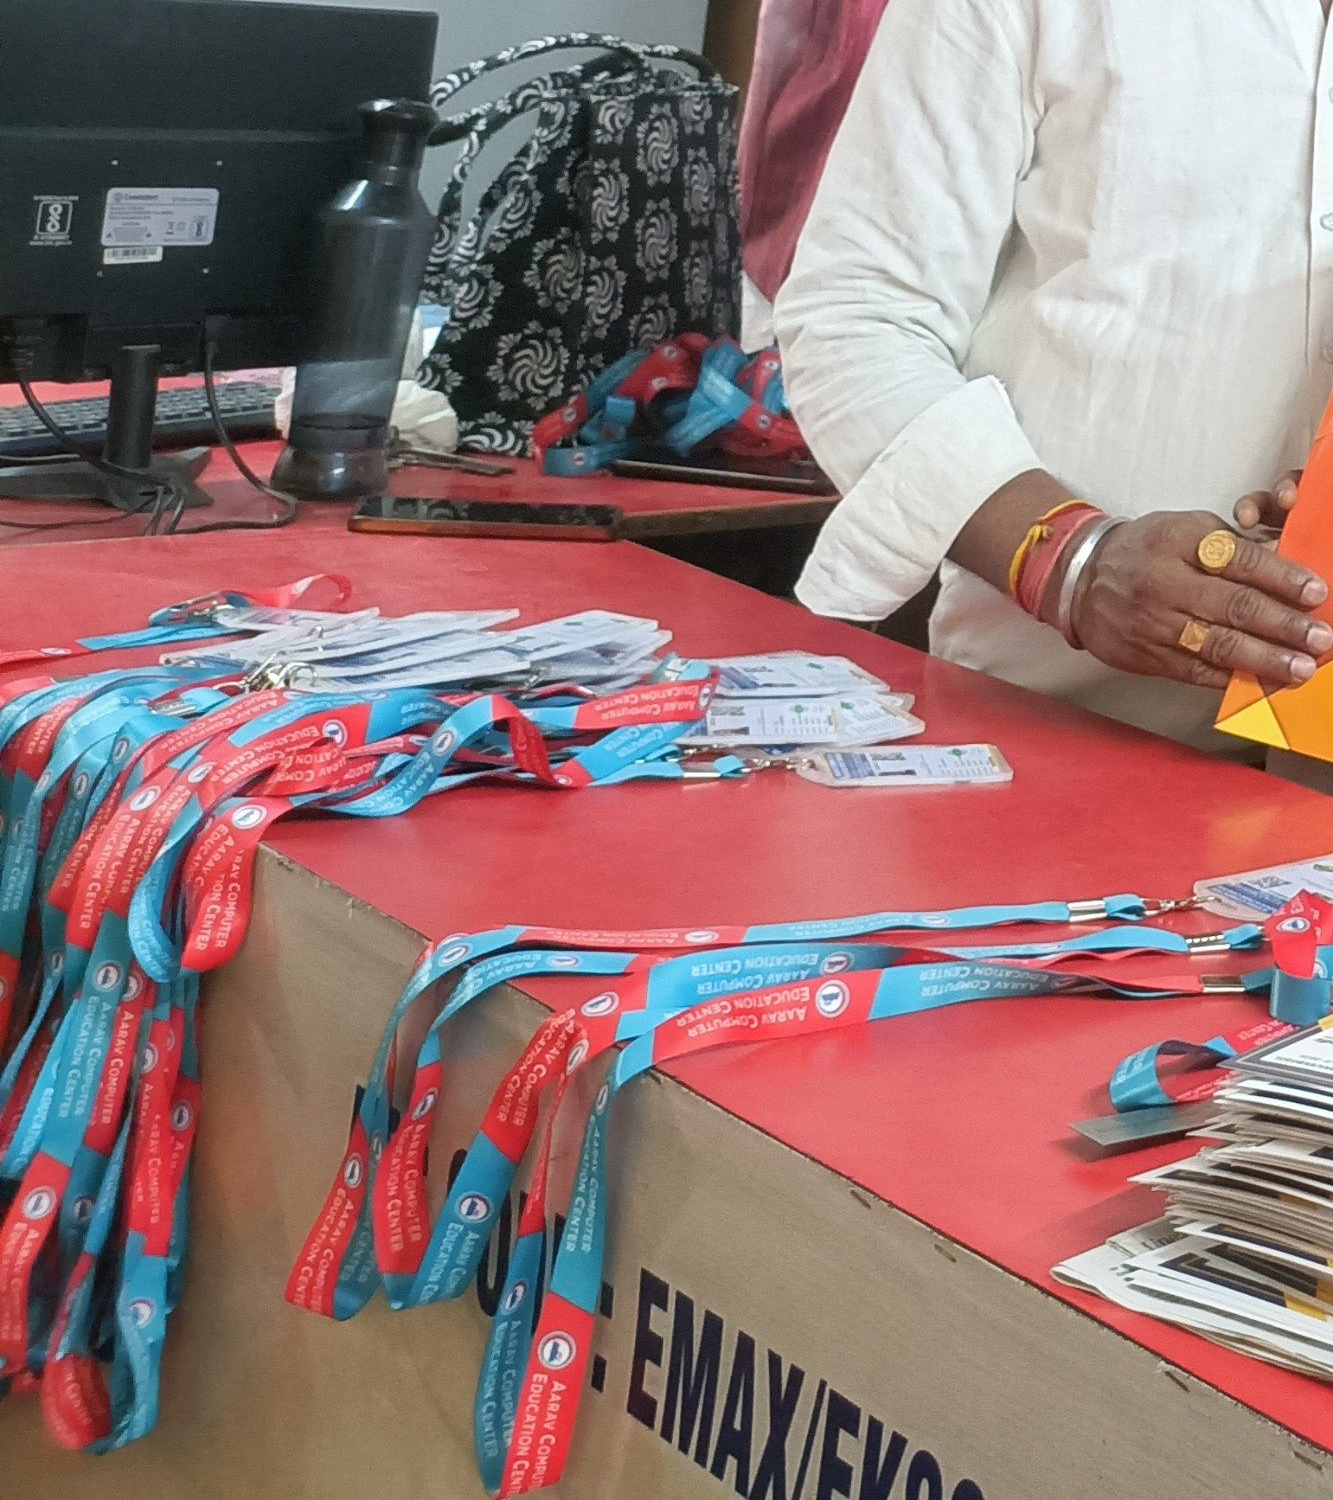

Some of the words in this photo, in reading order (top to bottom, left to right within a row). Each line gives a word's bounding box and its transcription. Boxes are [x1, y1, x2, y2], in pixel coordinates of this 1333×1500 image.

[196, 890, 223, 952] CENTER
[214, 879, 242, 949] COMPUTER
[690, 959, 741, 977] CENTER
[696, 974, 764, 995] COMPUTER
[745, 952, 819, 970] EDUCATION
[766, 967, 811, 985] AARAV
[675, 1000, 732, 1028] CENTER
[735, 986, 810, 1009] EDUCATION
[760, 1006, 806, 1026] AARAV
[115, 1009, 135, 1058] AARAV
[519, 1008, 577, 1075] EDUCATION
[546, 1019, 575, 1065] AARAV
[687, 1011, 759, 1038] COMPUTER
[100, 1057, 125, 1125] COMPUTER
[497, 1074, 521, 1123] CENTER
[512, 1063, 547, 1127] COMPUTER
[542, 1380, 567, 1430] AARAV
[627, 1267, 987, 1500] EMAX/EK
[516, 1372, 549, 1456] EDUCATION
[507, 1460, 530, 1498] CENT
[530, 1432, 557, 1492] COMPUT
